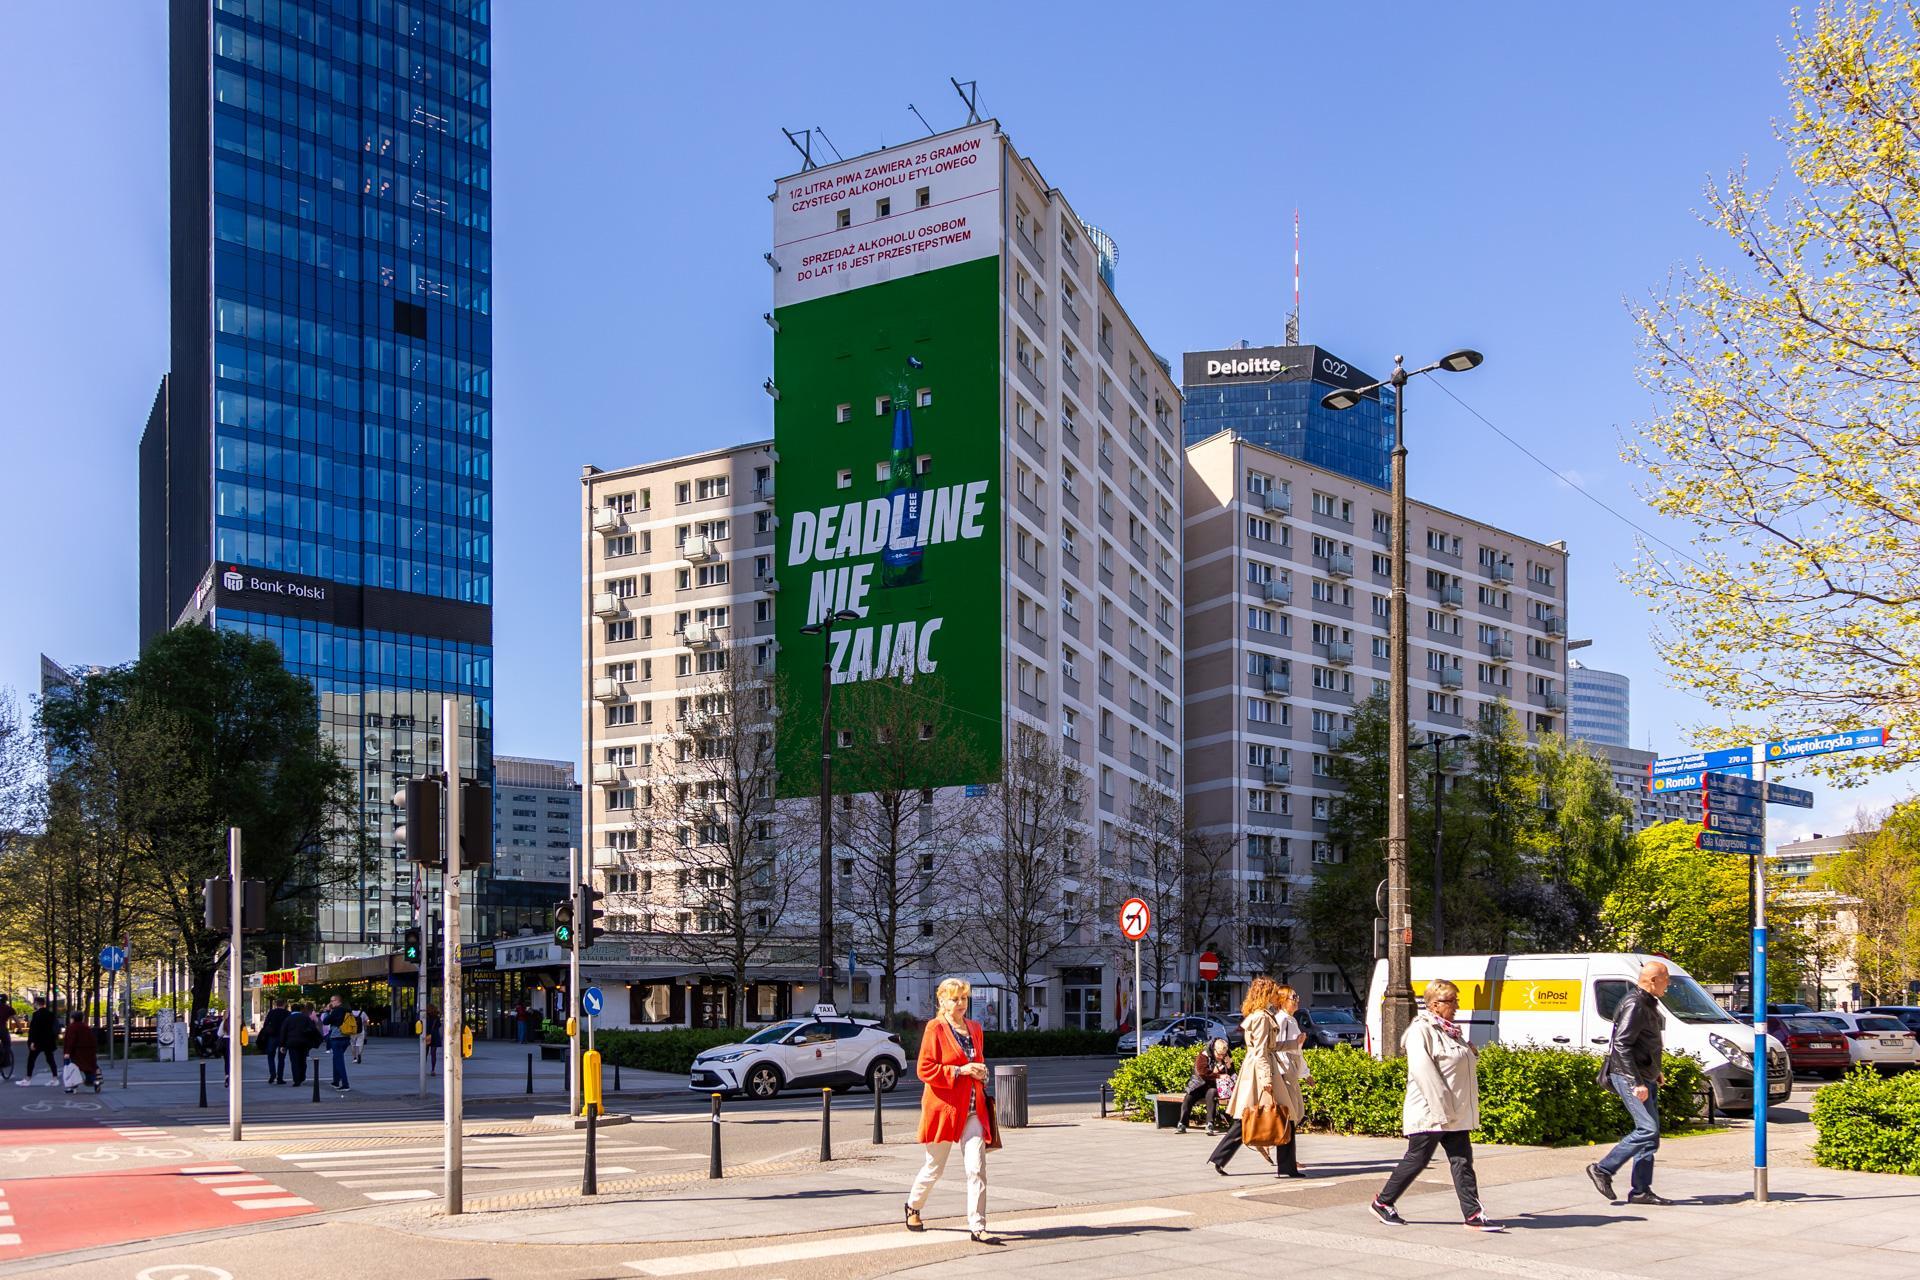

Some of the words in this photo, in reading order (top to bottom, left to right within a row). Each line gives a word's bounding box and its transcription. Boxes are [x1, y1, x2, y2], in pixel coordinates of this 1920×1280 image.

[789, 187, 803, 200] 1/2
[804, 179, 834, 196] LITRA
[836, 171, 862, 189] PIWA
[864, 159, 913, 178] ZAWIERA
[915, 154, 927, 165] 25
[930, 138, 981, 161] GRAMÓW
[792, 190, 846, 213] CZYSTEGO
[848, 173, 906, 196] ALKOHOLU
[908, 154, 977, 182] ETYLOWEGO
[802, 243, 855, 267] SPRZEDAŻ
[857, 230, 915, 253] ALKOHOLU
[918, 217, 966, 237] OSOBOM
[797, 271, 813, 282] DO
[815, 264, 833, 278] LAT
[837, 260, 848, 272] 18
[850, 253, 875, 269] JEST
[877, 230, 971, 261] PRZESTĘPSTWEM
[1207, 358, 1286, 375] Deloitte.
[1322, 358, 1348, 379] Q22
[909, 492, 918, 519] FREE
[788, 480, 989, 567] DEADLINE
[251, 578, 284, 593] Bank
[288, 583, 325, 600] Polski
[807, 563, 874, 625] NIE
[830, 617, 943, 685] ZAJĄC
[1782, 735, 1853, 755] Świętokrzyska
[1855, 736, 1870, 745] 350
[1654, 757, 1682, 767] Ambasada
[1728, 756, 1740, 764] 270
[1654, 765, 1677, 775] Embassy
[1677, 763, 1684, 771] of
[1684, 761, 1708, 770] Australia
[1665, 776, 1696, 789] Rondo
[1702, 835, 1713, 847] Sala
[1714, 836, 1747, 850] Kongresowa
[1538, 991, 1568, 1000] InPost
